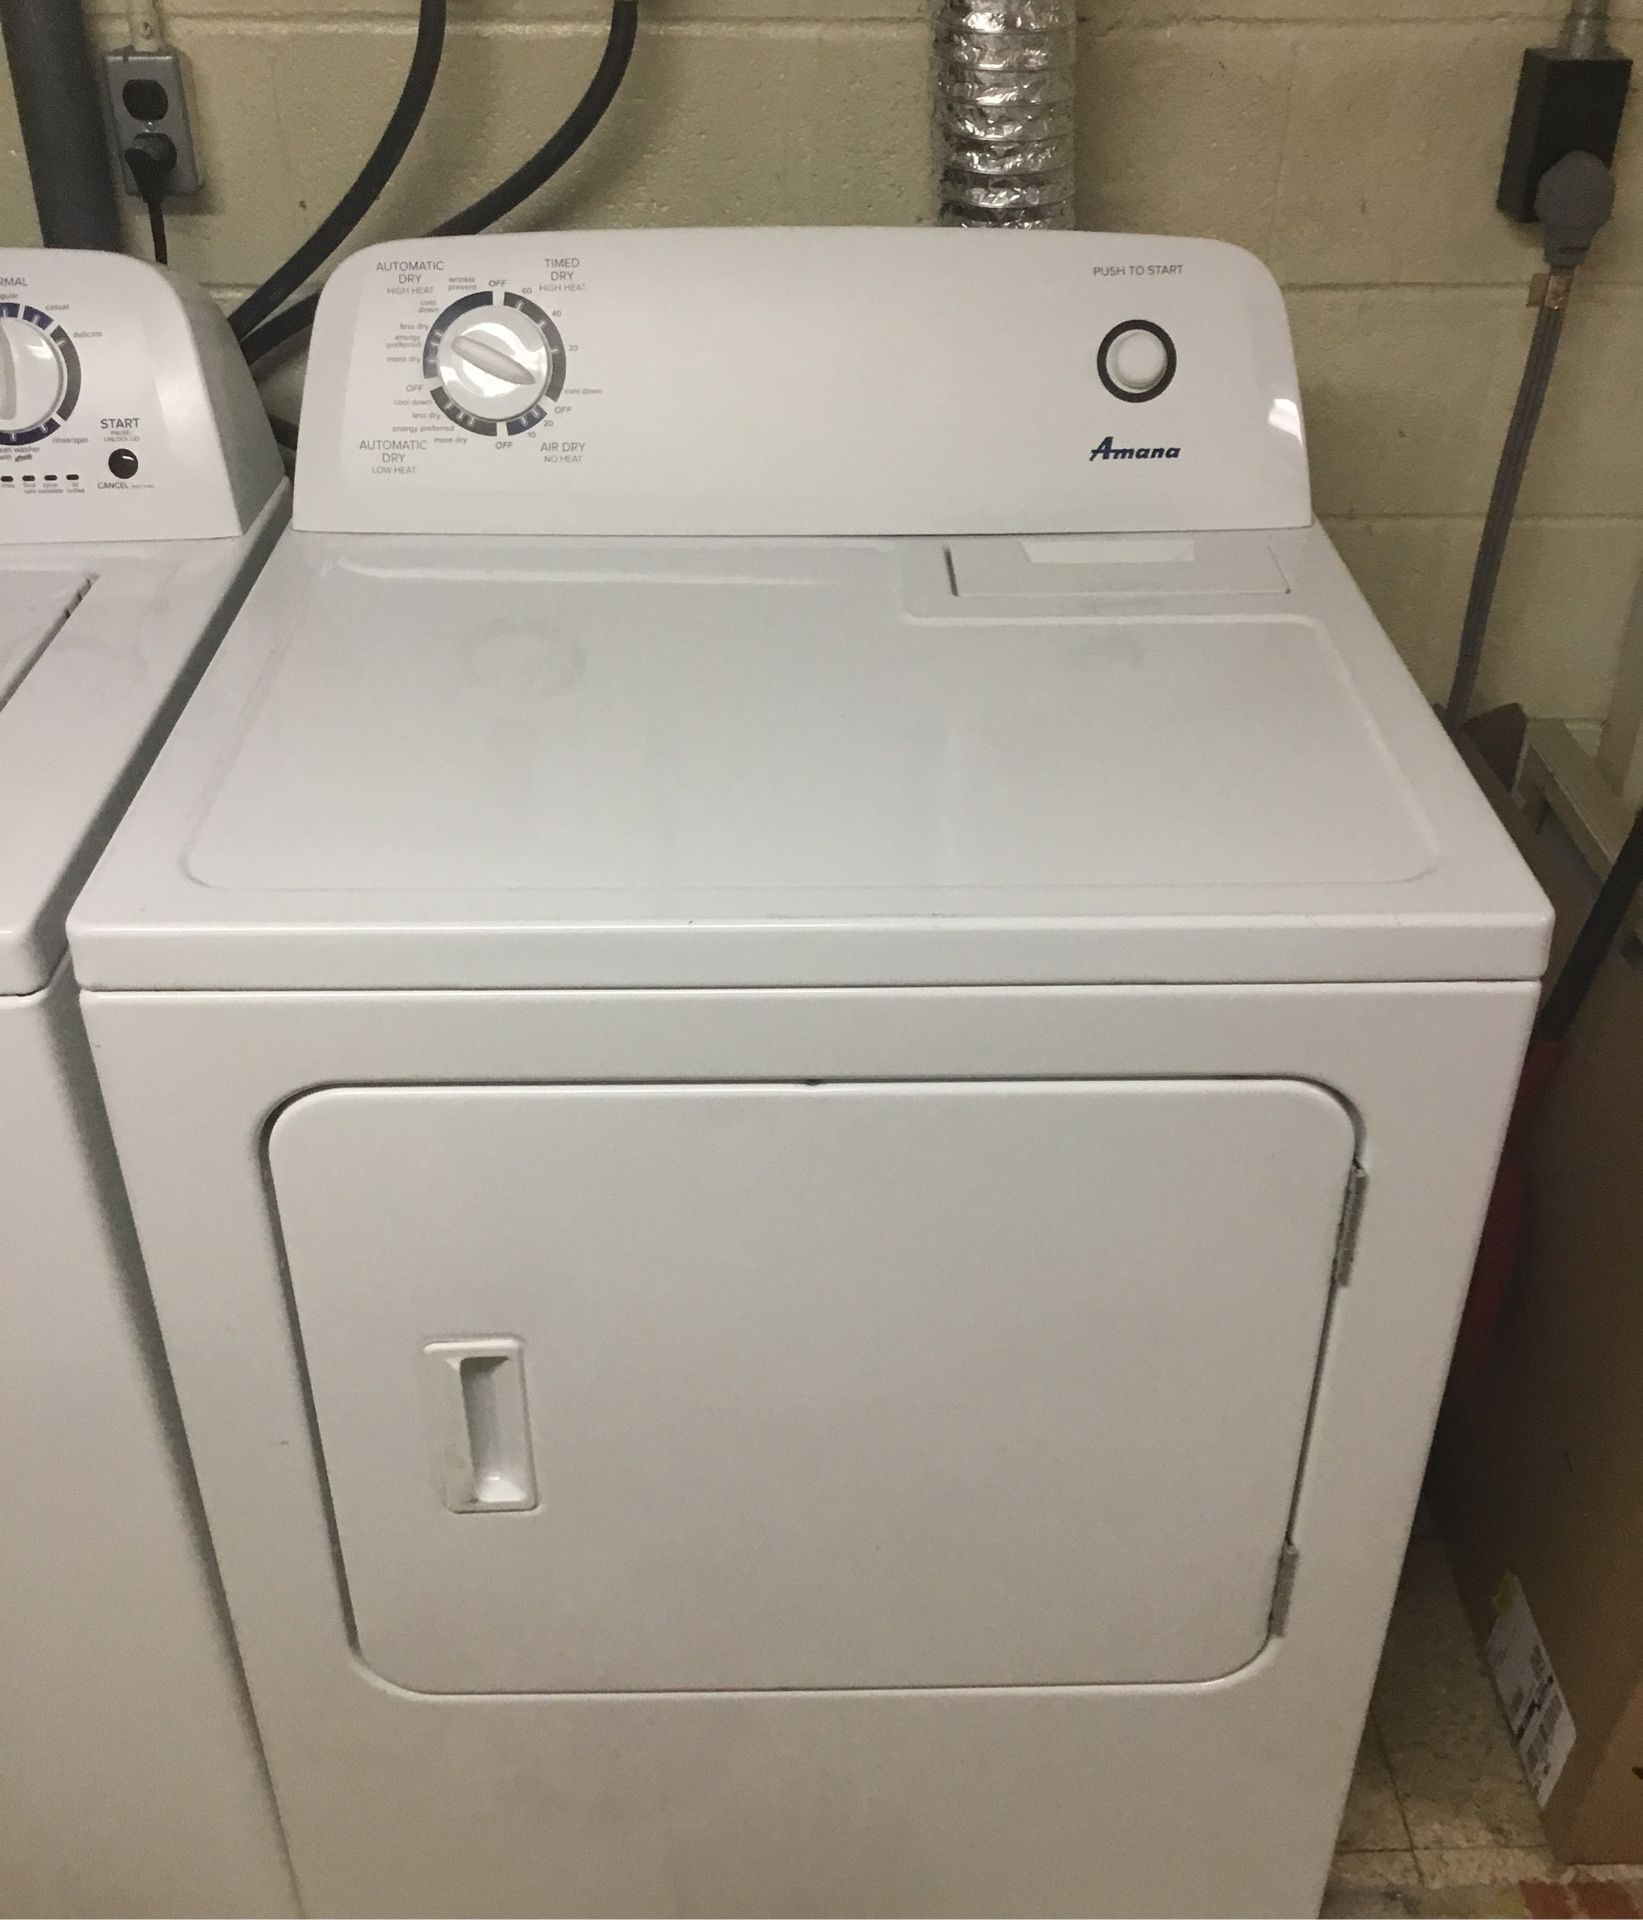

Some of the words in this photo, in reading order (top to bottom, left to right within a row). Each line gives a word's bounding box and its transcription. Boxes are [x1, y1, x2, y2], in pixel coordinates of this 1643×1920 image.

[376, 261, 443, 271] AUTOMATIC
[545, 258, 580, 268] TIMED
[1094, 266, 1126, 276] PUSH
[1129, 266, 1145, 275] TO
[1147, 265, 1183, 275] START
[399, 274, 422, 284] DRY
[551, 271, 574, 281] DRY
[387, 287, 409, 295] HIGH
[522, 287, 533, 295] 60
[564, 283, 586, 291] HEAT
[555, 406, 572, 414] OFF
[101, 418, 140, 429] START
[360, 440, 427, 450] AUTOMATIC
[541, 443, 559, 452] AIR
[562, 442, 585, 452] DRY
[1090, 436, 1181, 461] Amana
[382, 453, 405, 463] DRY
[372, 466, 392, 474] LOW
[394, 466, 416, 474] HEAT
